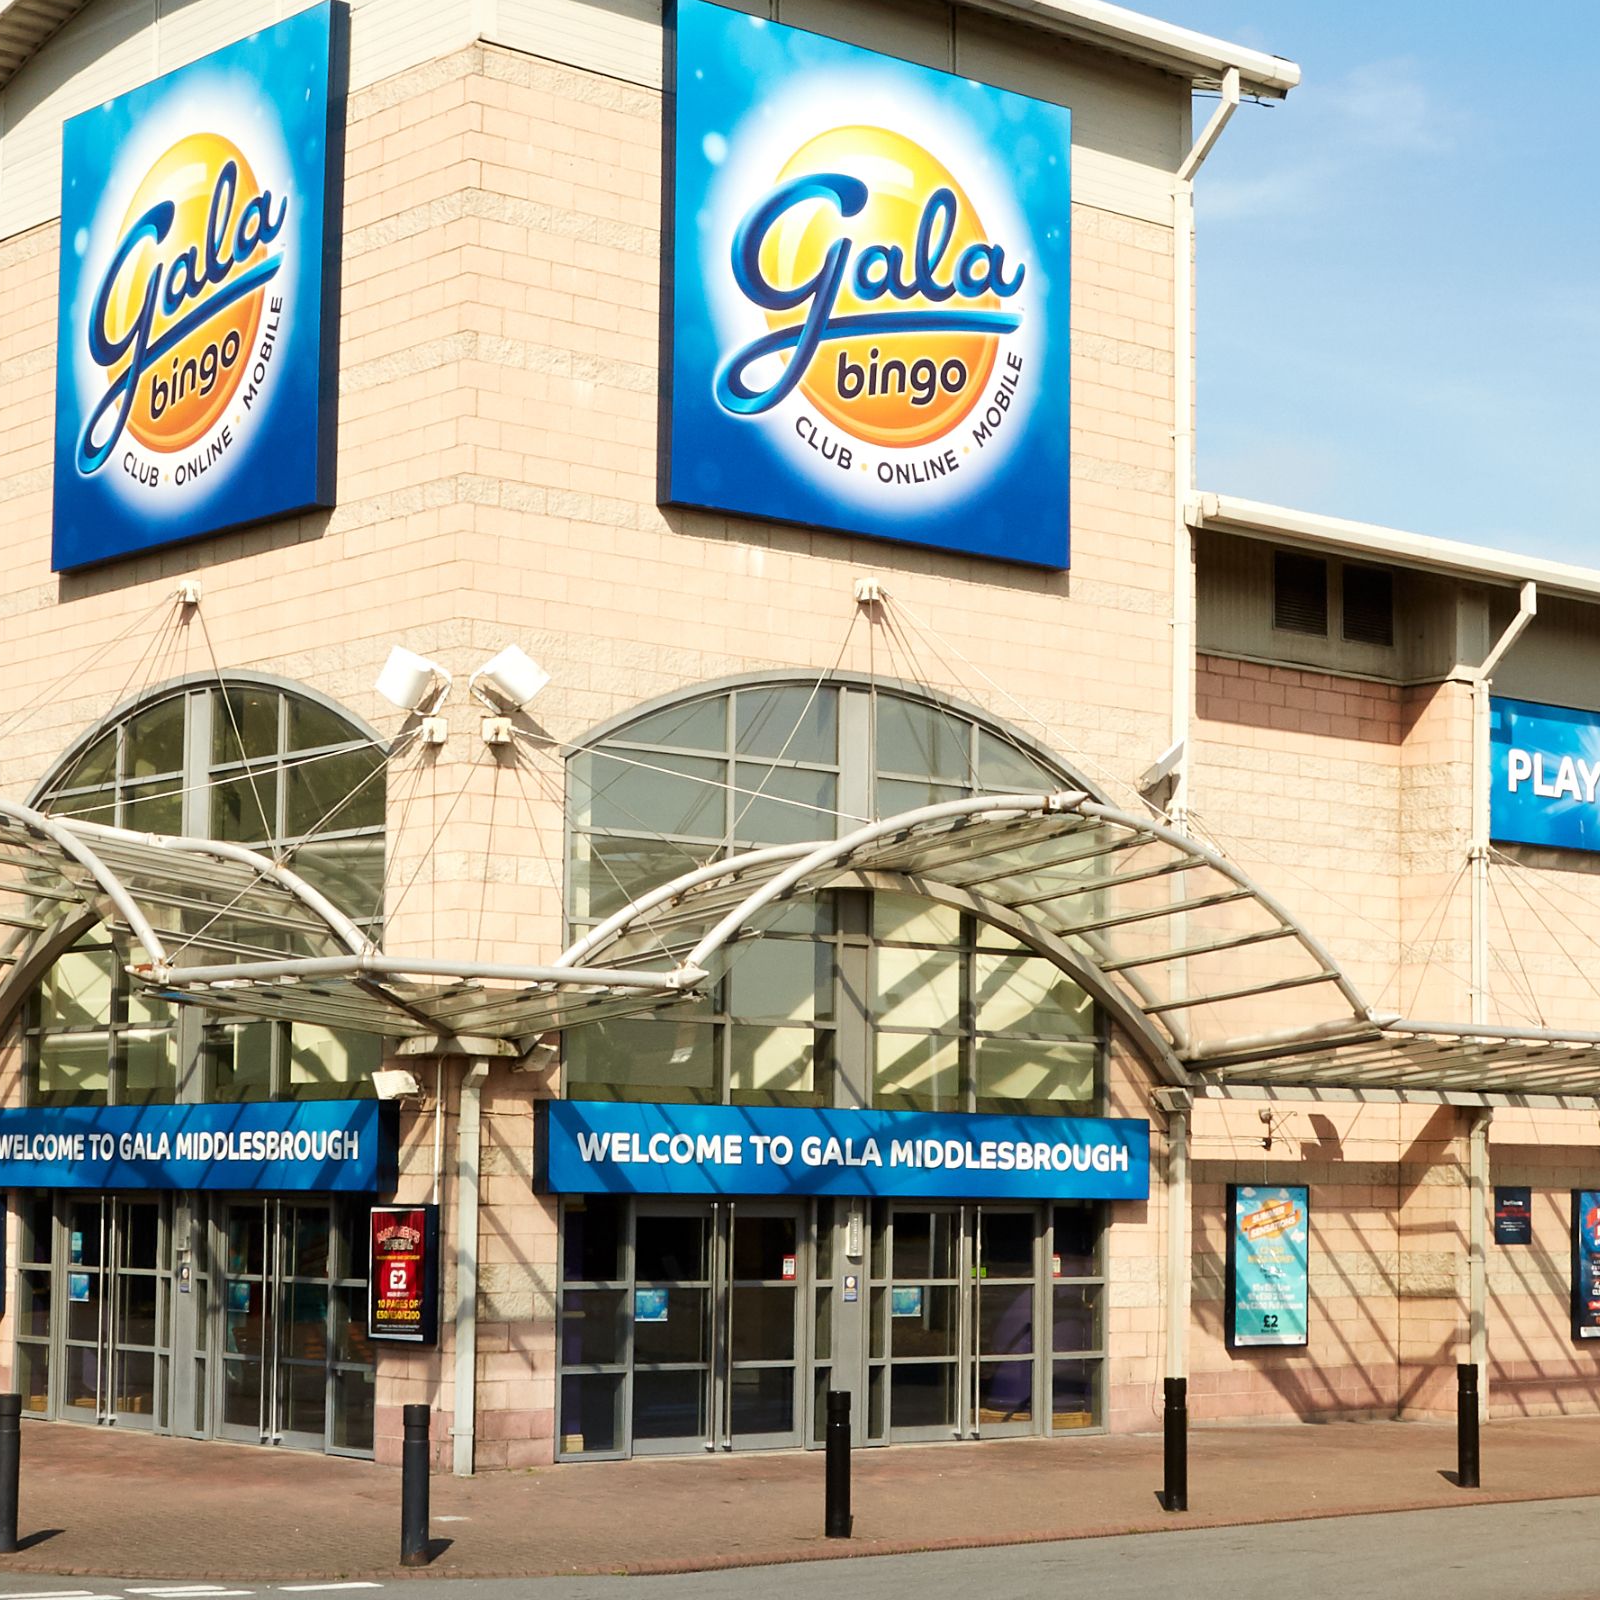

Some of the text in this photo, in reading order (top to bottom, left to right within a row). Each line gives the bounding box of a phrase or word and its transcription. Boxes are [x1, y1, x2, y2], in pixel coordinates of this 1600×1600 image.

[123, 296, 284, 488] CLUB ONLINE MOBILE
[150, 328, 241, 420] bingo
[838, 348, 968, 405] bingo
[795, 351, 1024, 485] CLUB ONLINE MOBILE
[88, 1132, 114, 1162] TO
[119, 1132, 170, 1161] GALA
[175, 1130, 359, 1161] MIDDLESBROUGH
[577, 1131, 1129, 1172] WELCOME TO GALA MIDDLESBROUGH
[389, 1269, 407, 1289] £2
[1263, 1314, 1278, 1328] £2
